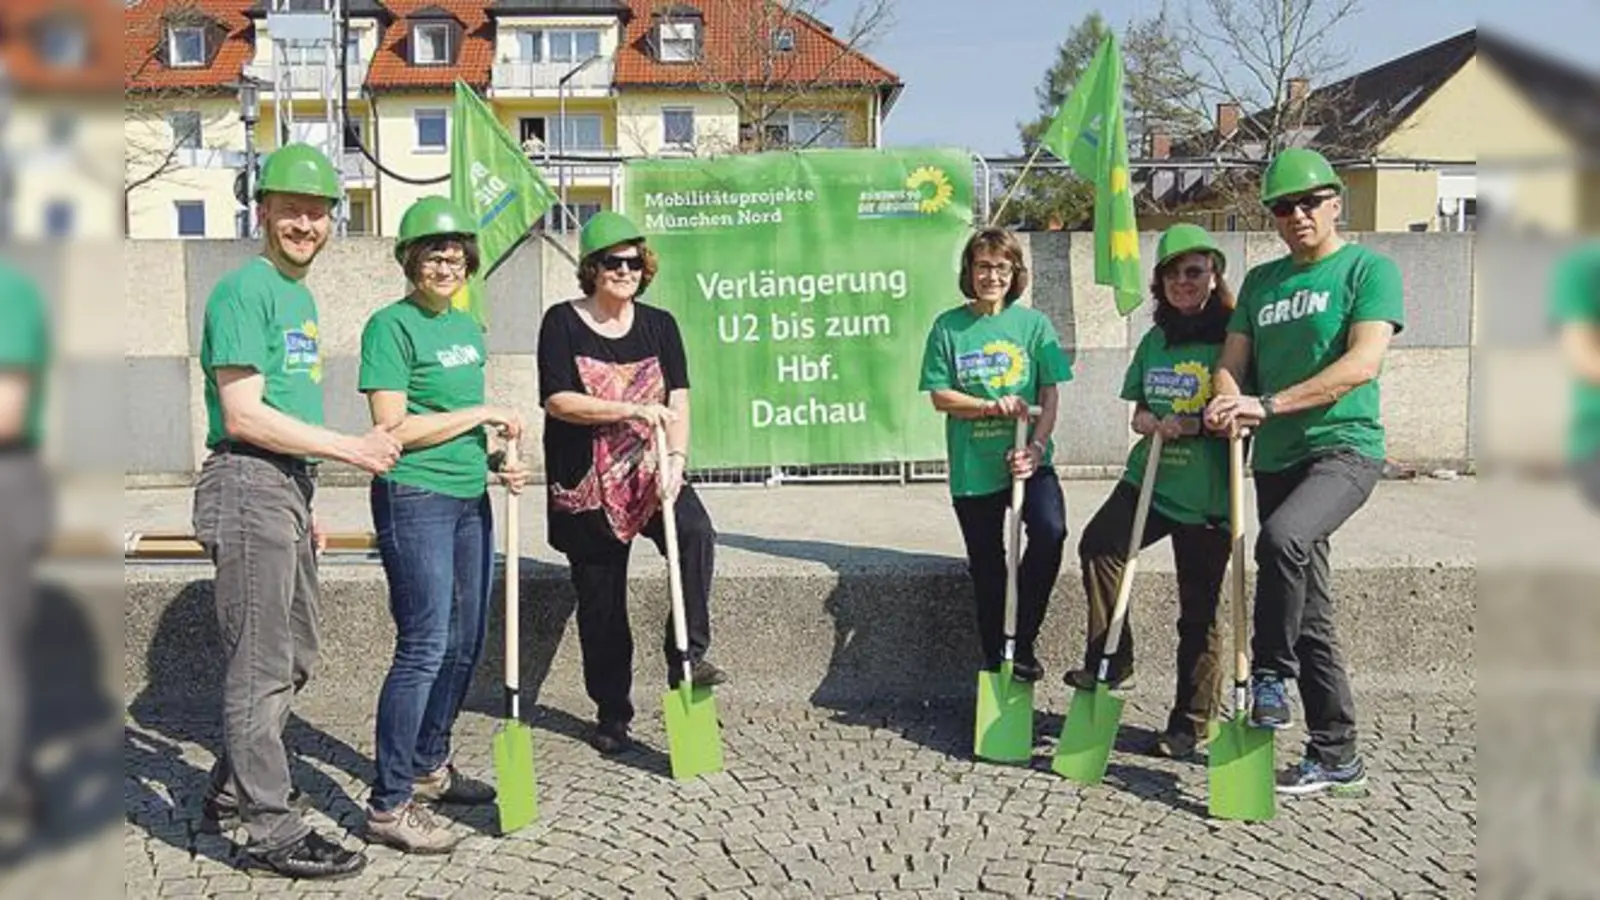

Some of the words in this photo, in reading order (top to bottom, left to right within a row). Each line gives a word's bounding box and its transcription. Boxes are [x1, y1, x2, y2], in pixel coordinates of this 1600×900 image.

[645, 187, 815, 208] Mobilitätsprojekte
[645, 211, 733, 230] München
[738, 209, 782, 225] Nord
[696, 269, 907, 302] Verlängerung
[1258, 289, 1330, 327] GRÜN
[718, 314, 760, 343] U2
[771, 312, 815, 340] bis
[826, 313, 890, 336] zum
[777, 355, 839, 382] Hbf.
[752, 398, 867, 427] Dachau
